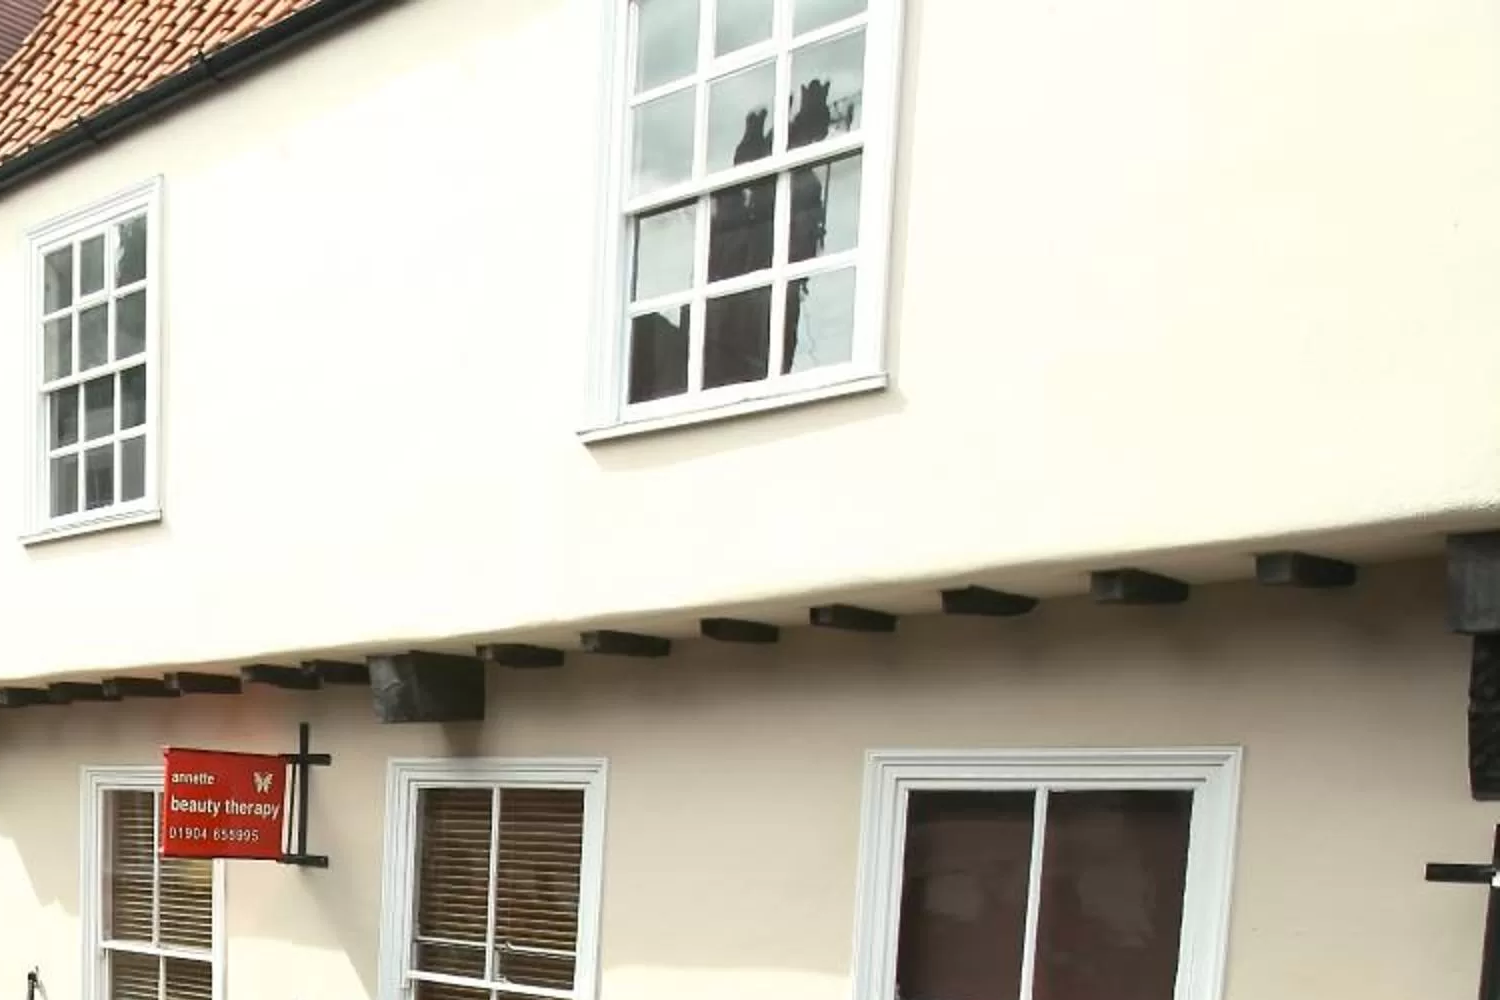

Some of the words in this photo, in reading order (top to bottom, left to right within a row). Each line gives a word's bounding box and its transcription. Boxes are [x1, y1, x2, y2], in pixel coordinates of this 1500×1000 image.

[171, 771, 216, 785] annette
[171, 794, 221, 817] beauty
[225, 799, 280, 820] therapy
[169, 827, 208, 840] 01904
